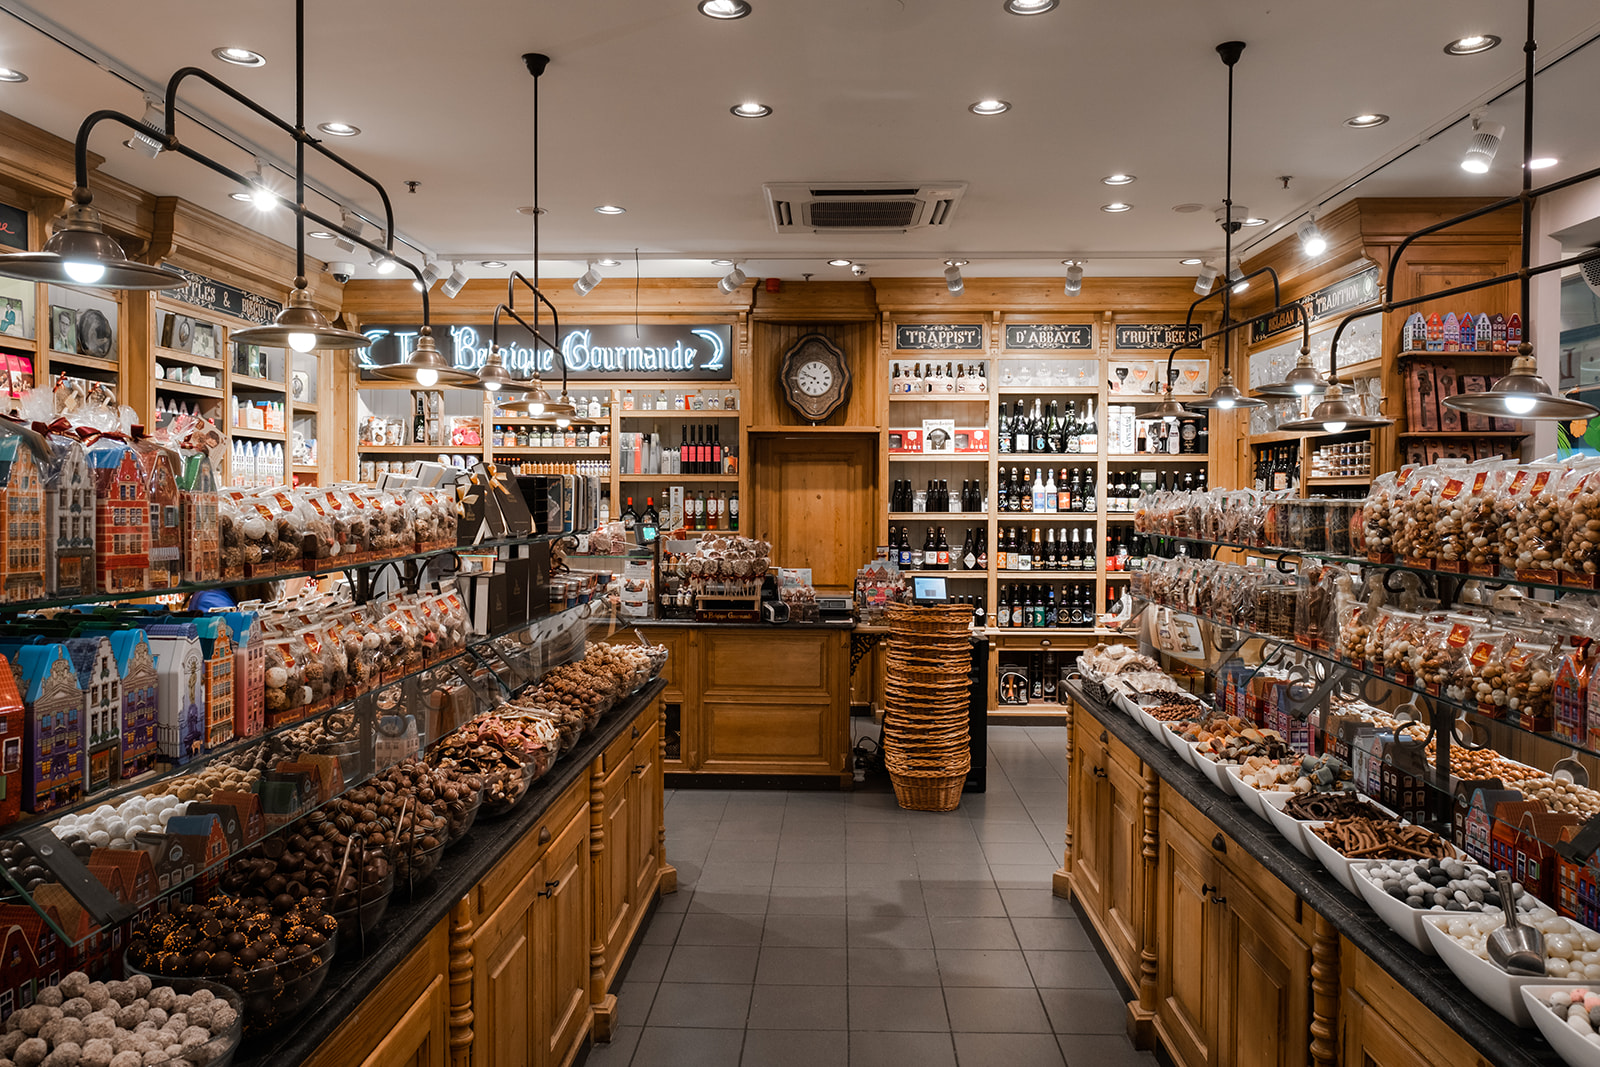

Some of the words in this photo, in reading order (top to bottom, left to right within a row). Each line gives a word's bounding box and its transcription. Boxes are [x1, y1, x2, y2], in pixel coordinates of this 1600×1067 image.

[173, 280, 216, 303] FFLES
[223, 291, 231, 308] &
[241, 298, 278, 322] BISCUITS
[1316, 283, 1359, 313] TRADITION
[905, 329, 976, 344] TRAPPIST
[1016, 329, 1081, 344] D'ABBAYE
[1122, 330, 1161, 344] FRUIT
[562, 329, 698, 371] Gourmande
